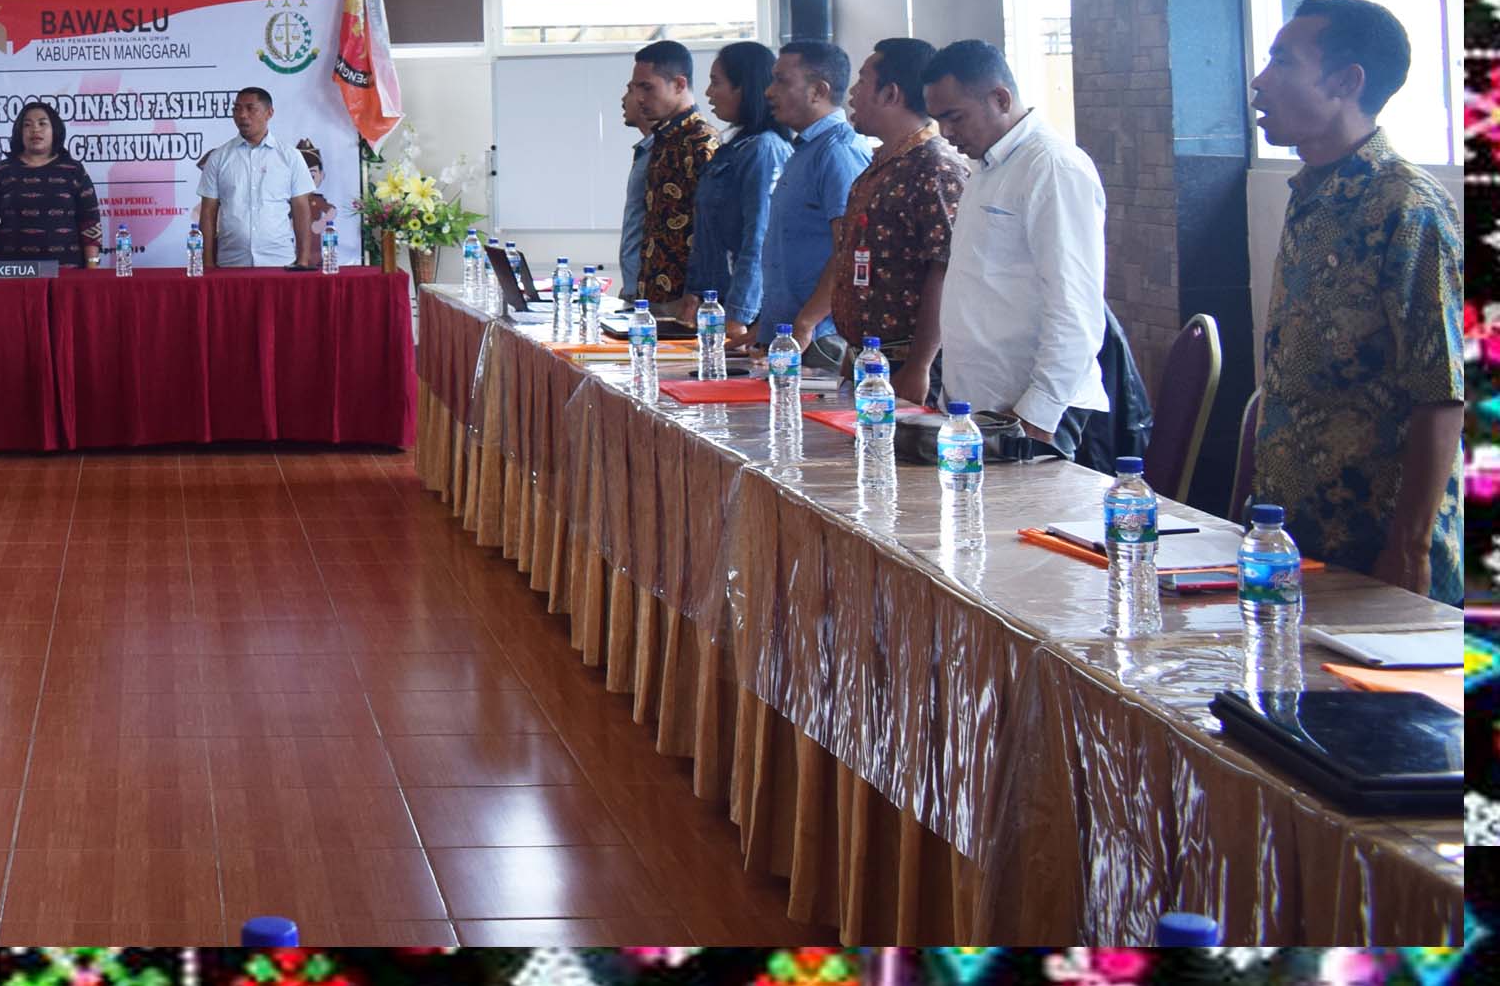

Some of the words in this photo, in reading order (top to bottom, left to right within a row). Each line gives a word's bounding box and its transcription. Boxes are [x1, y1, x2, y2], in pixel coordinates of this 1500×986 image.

[41, 8, 169, 35] BAWASLU
[36, 44, 110, 62] KABUPATEN
[114, 42, 191, 60] MANGGARAI
[69, 132, 203, 163] GAKKUMDU
